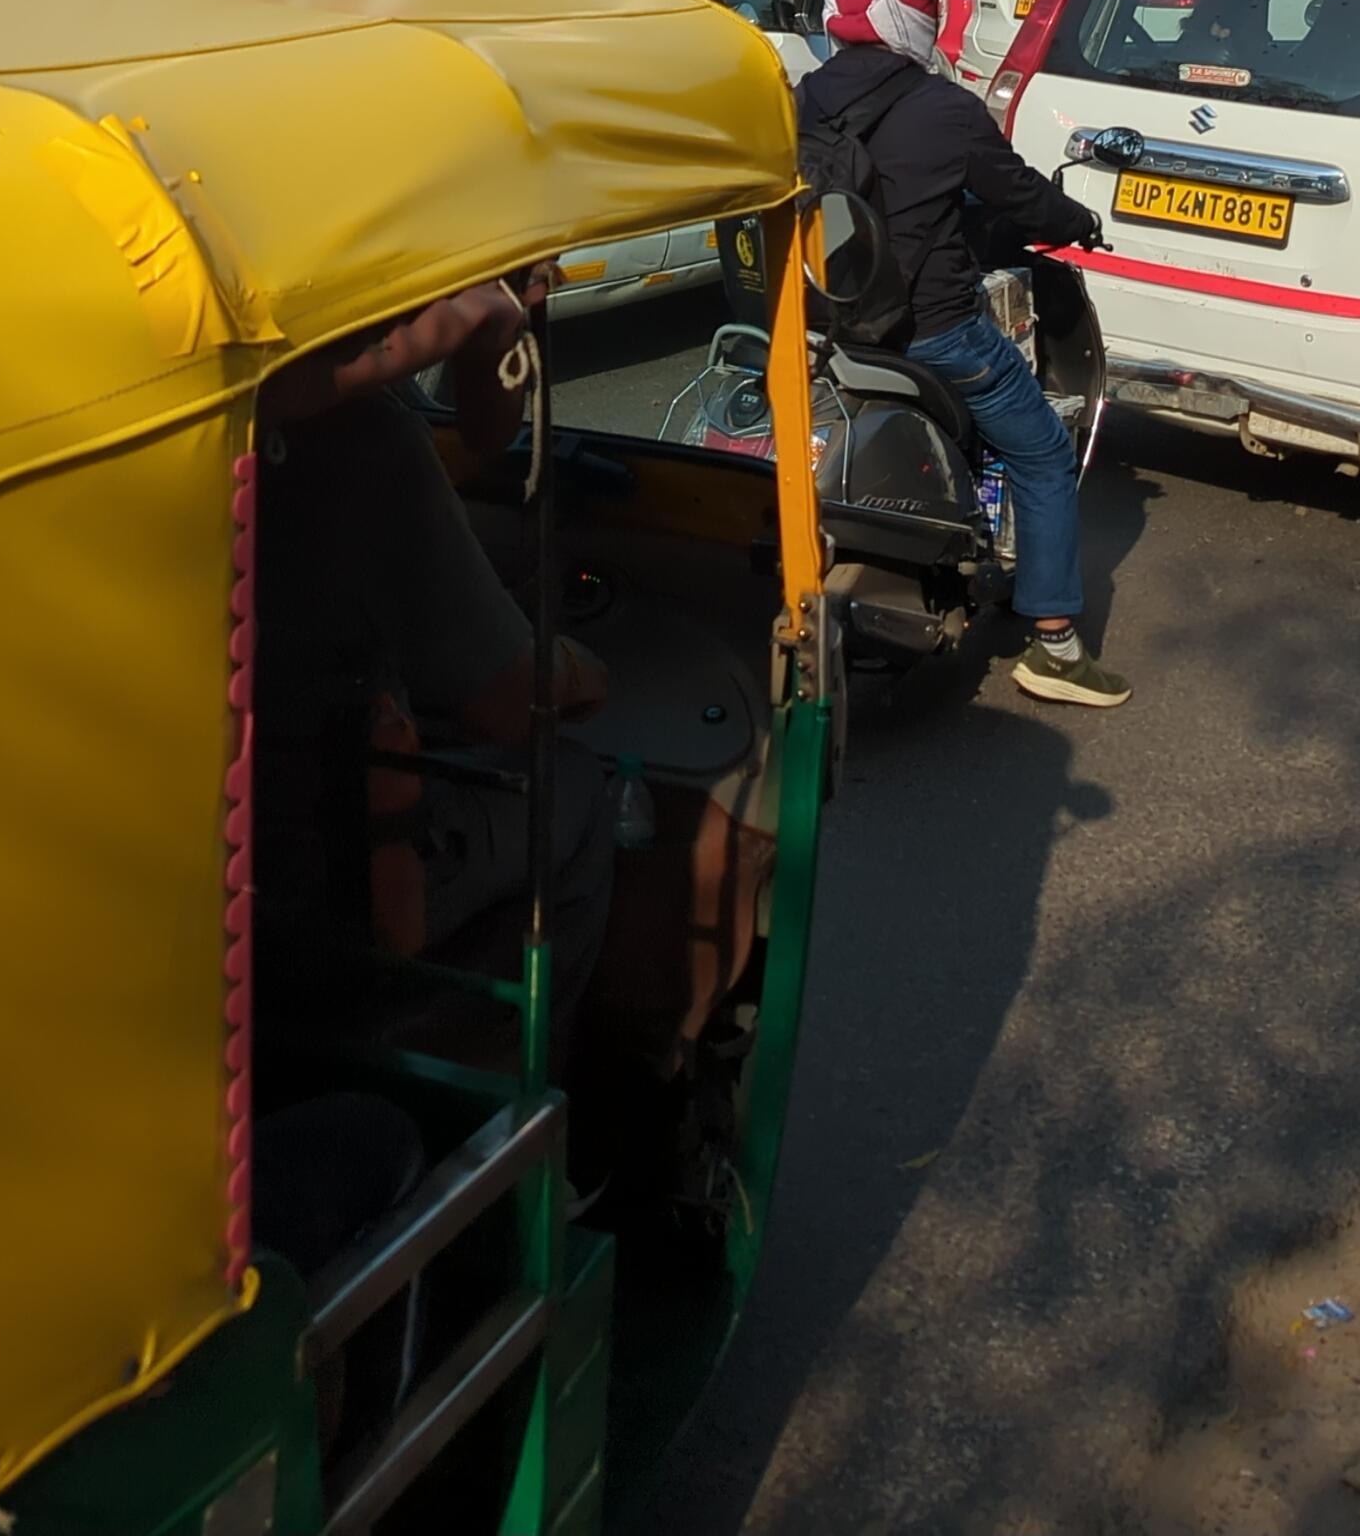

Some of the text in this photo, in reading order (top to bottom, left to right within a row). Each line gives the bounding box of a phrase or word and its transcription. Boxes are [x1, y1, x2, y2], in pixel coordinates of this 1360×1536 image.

[1141, 156, 1290, 188] AGONR
[1132, 181, 1286, 231] UP14NT8815
[740, 394, 759, 404] TVS
